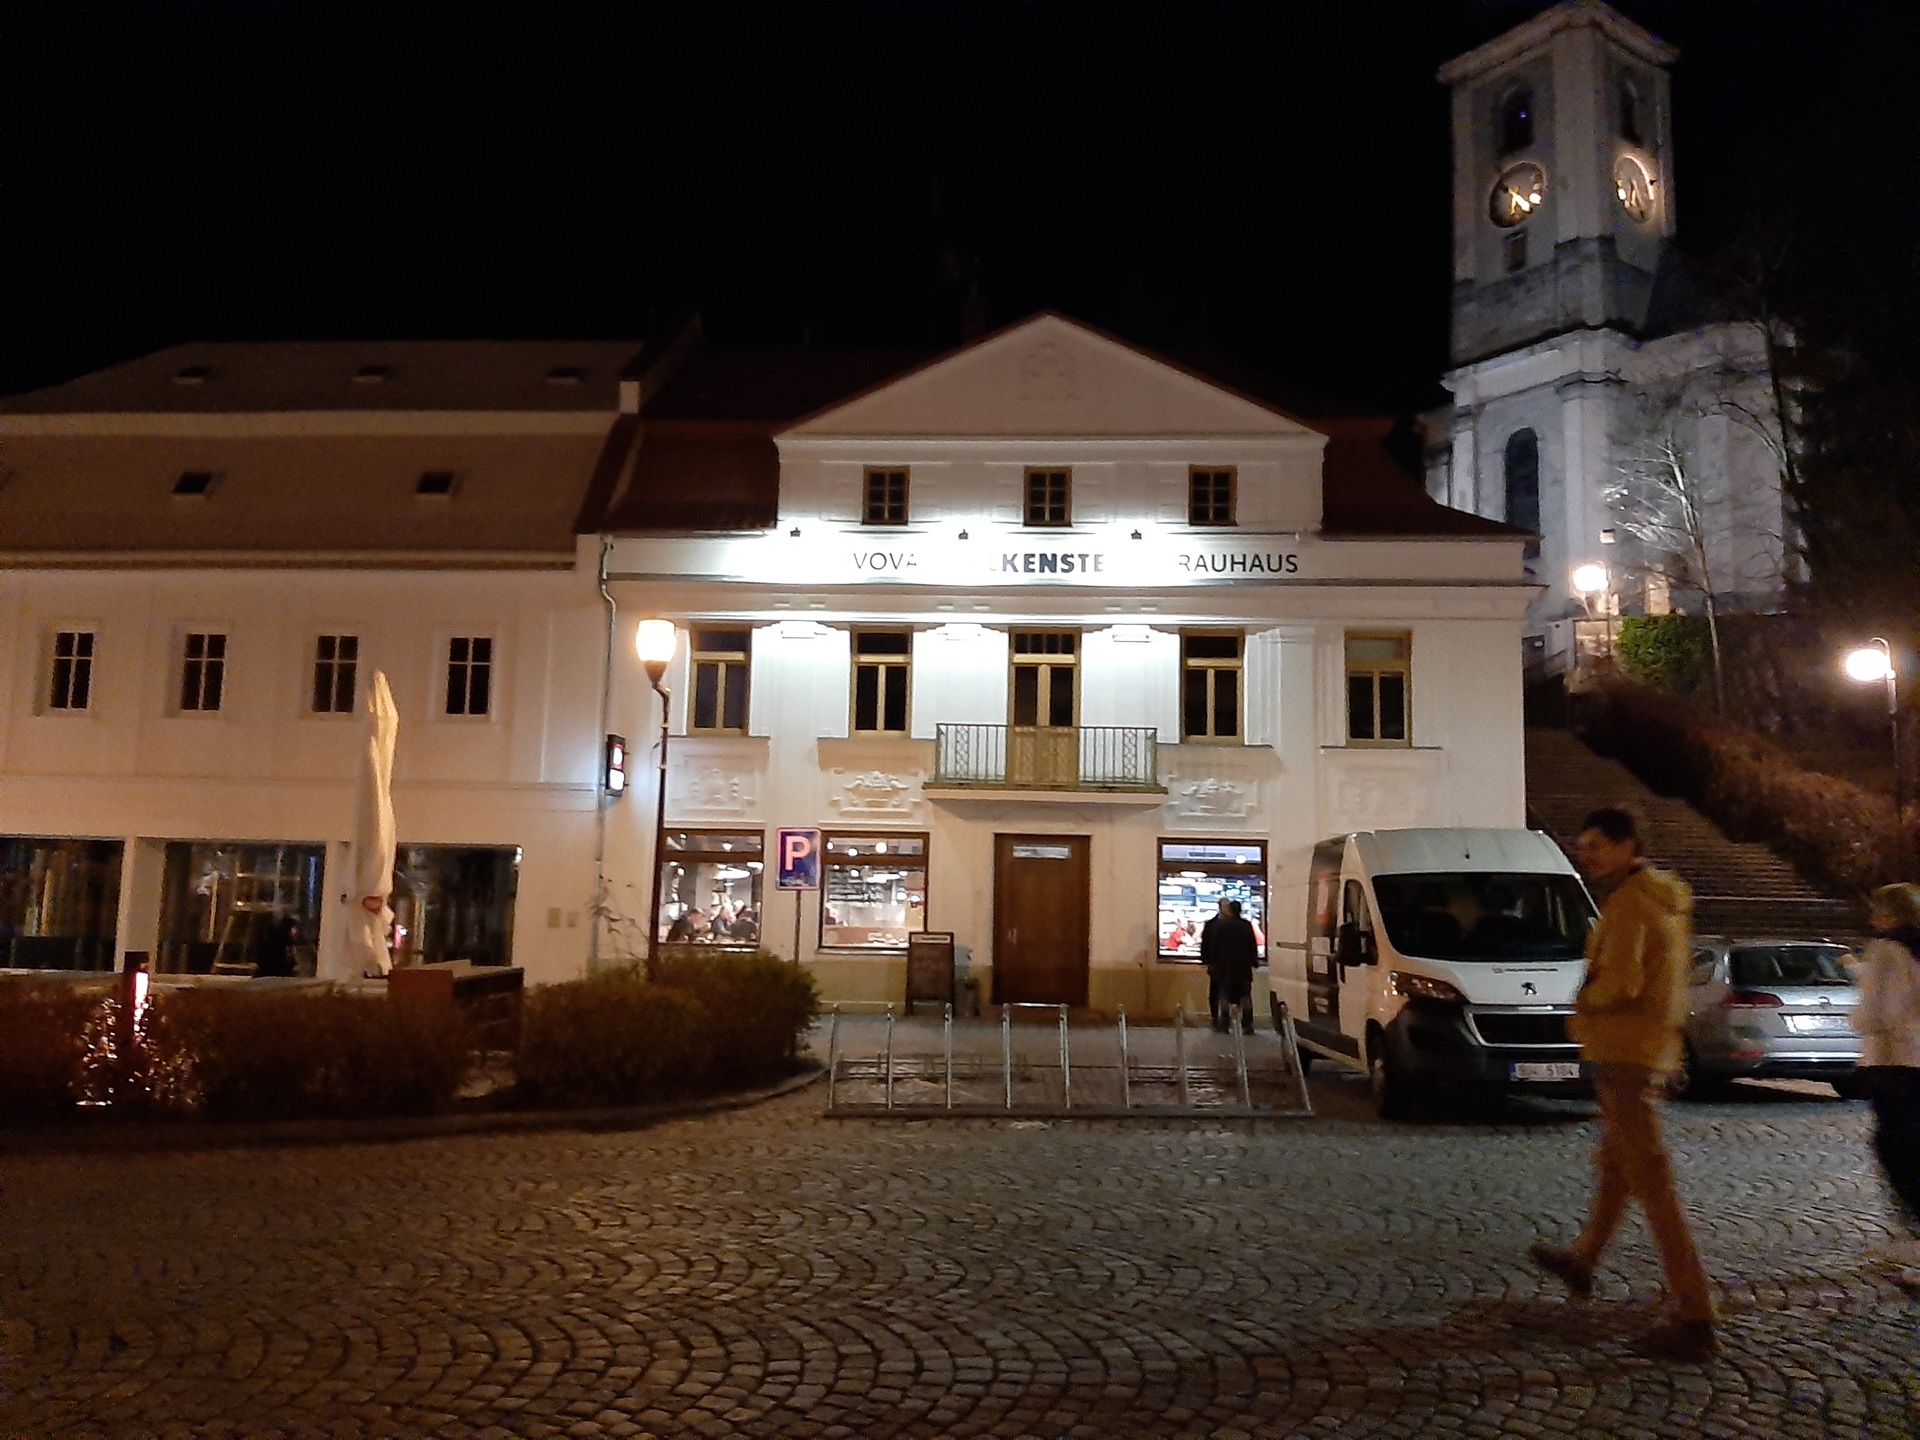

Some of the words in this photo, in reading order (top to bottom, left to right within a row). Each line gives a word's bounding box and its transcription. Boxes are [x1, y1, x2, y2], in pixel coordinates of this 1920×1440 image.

[853, 551, 918, 571] VOVA
[987, 552, 1105, 574] KENSTE
[1178, 553, 1299, 573] RAUHAUS
[785, 835, 811, 870] P
